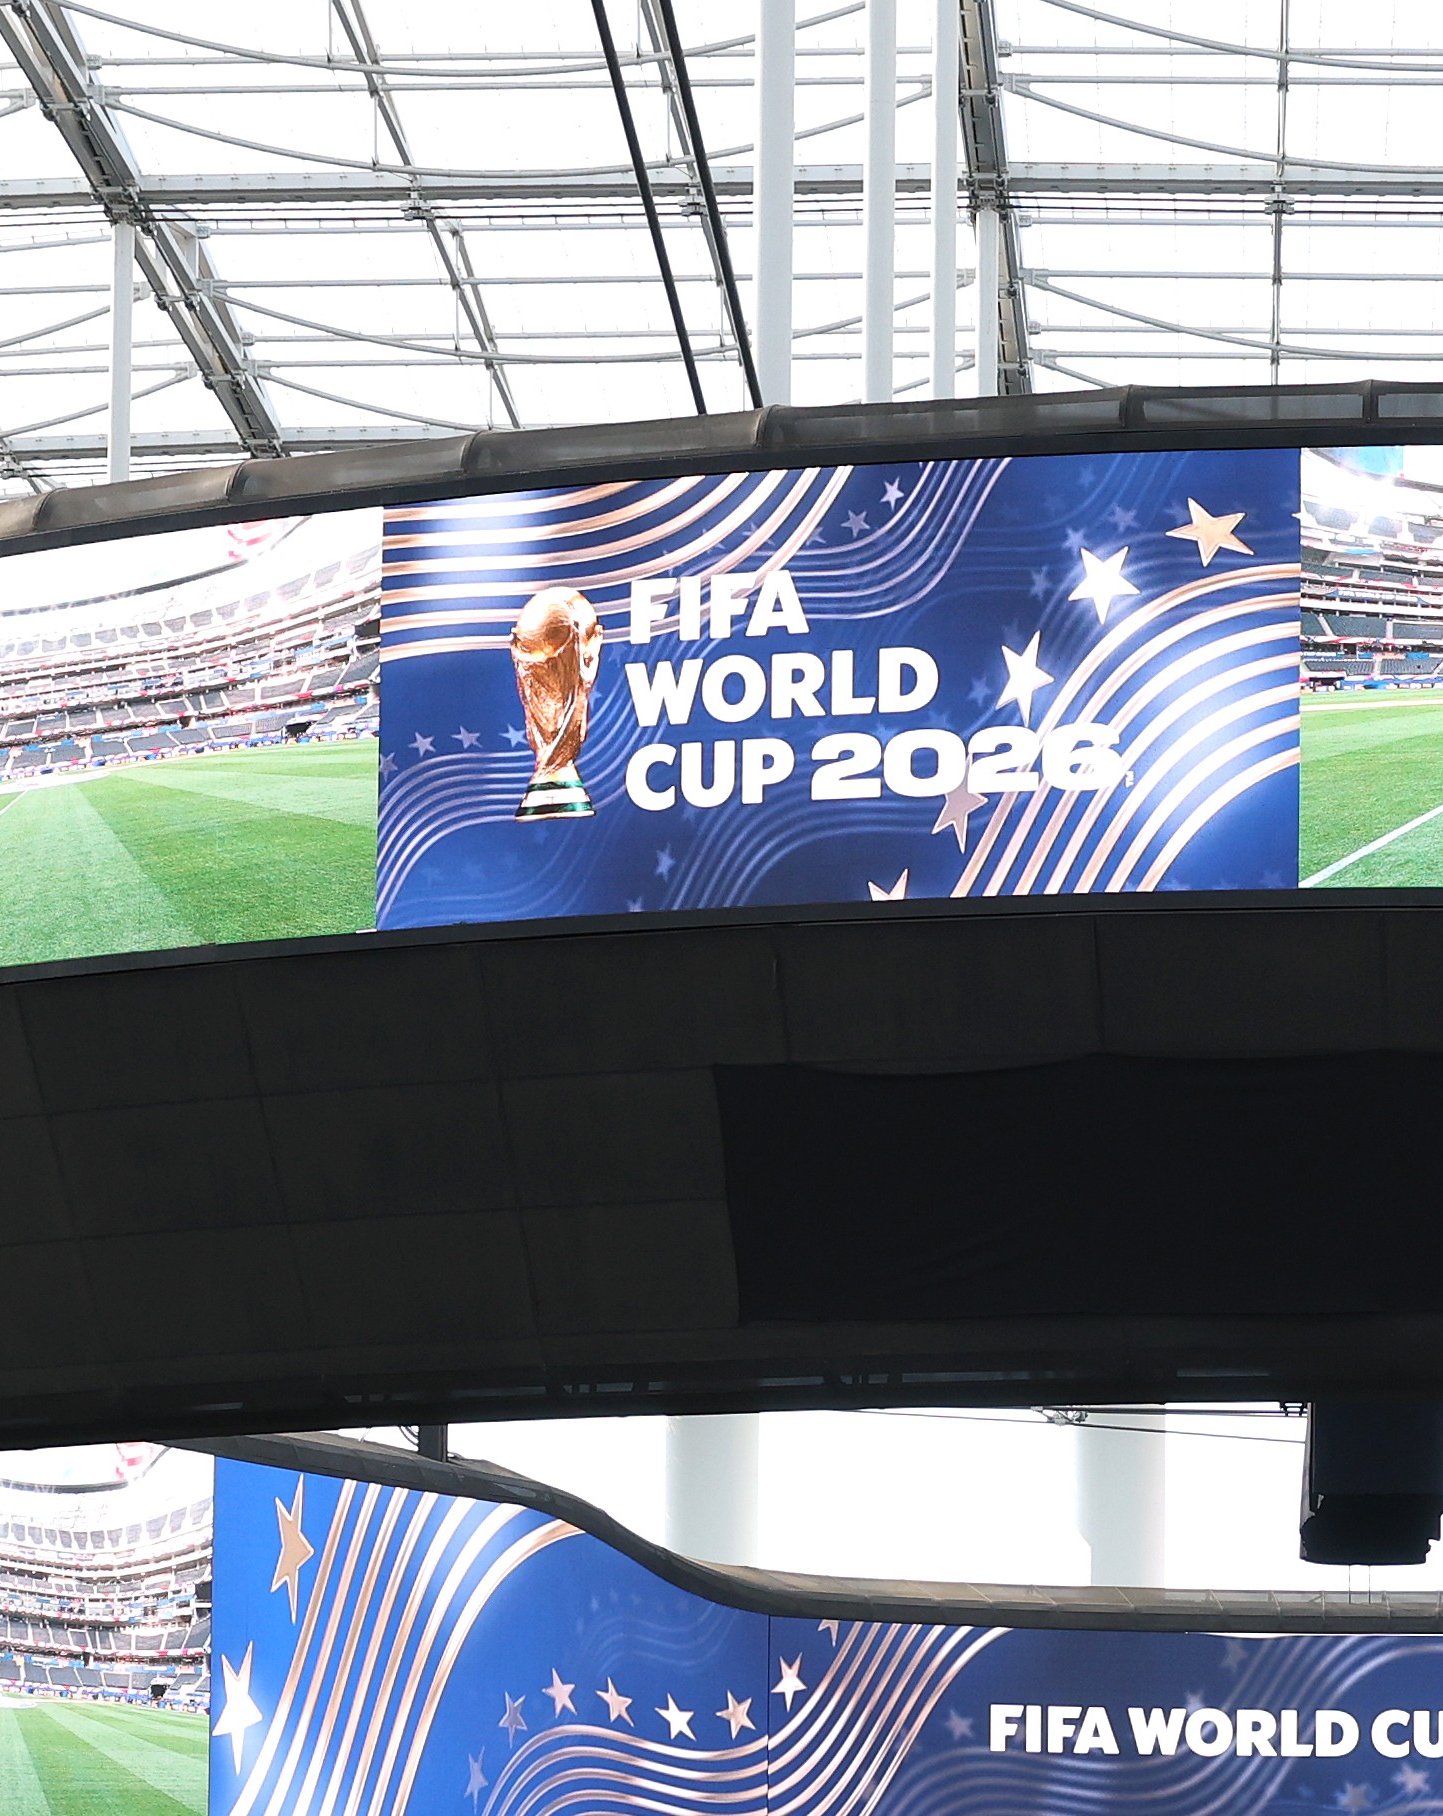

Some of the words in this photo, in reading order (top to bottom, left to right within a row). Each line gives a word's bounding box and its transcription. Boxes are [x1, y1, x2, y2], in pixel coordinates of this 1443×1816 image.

[630, 569, 811, 646] FIFA
[624, 647, 939, 729] WORLD
[625, 738, 795, 812] CUP
[812, 723, 1125, 800] 2026
[989, 1704, 1120, 1755] FIFA
[1127, 1704, 1360, 1759] WORLD
